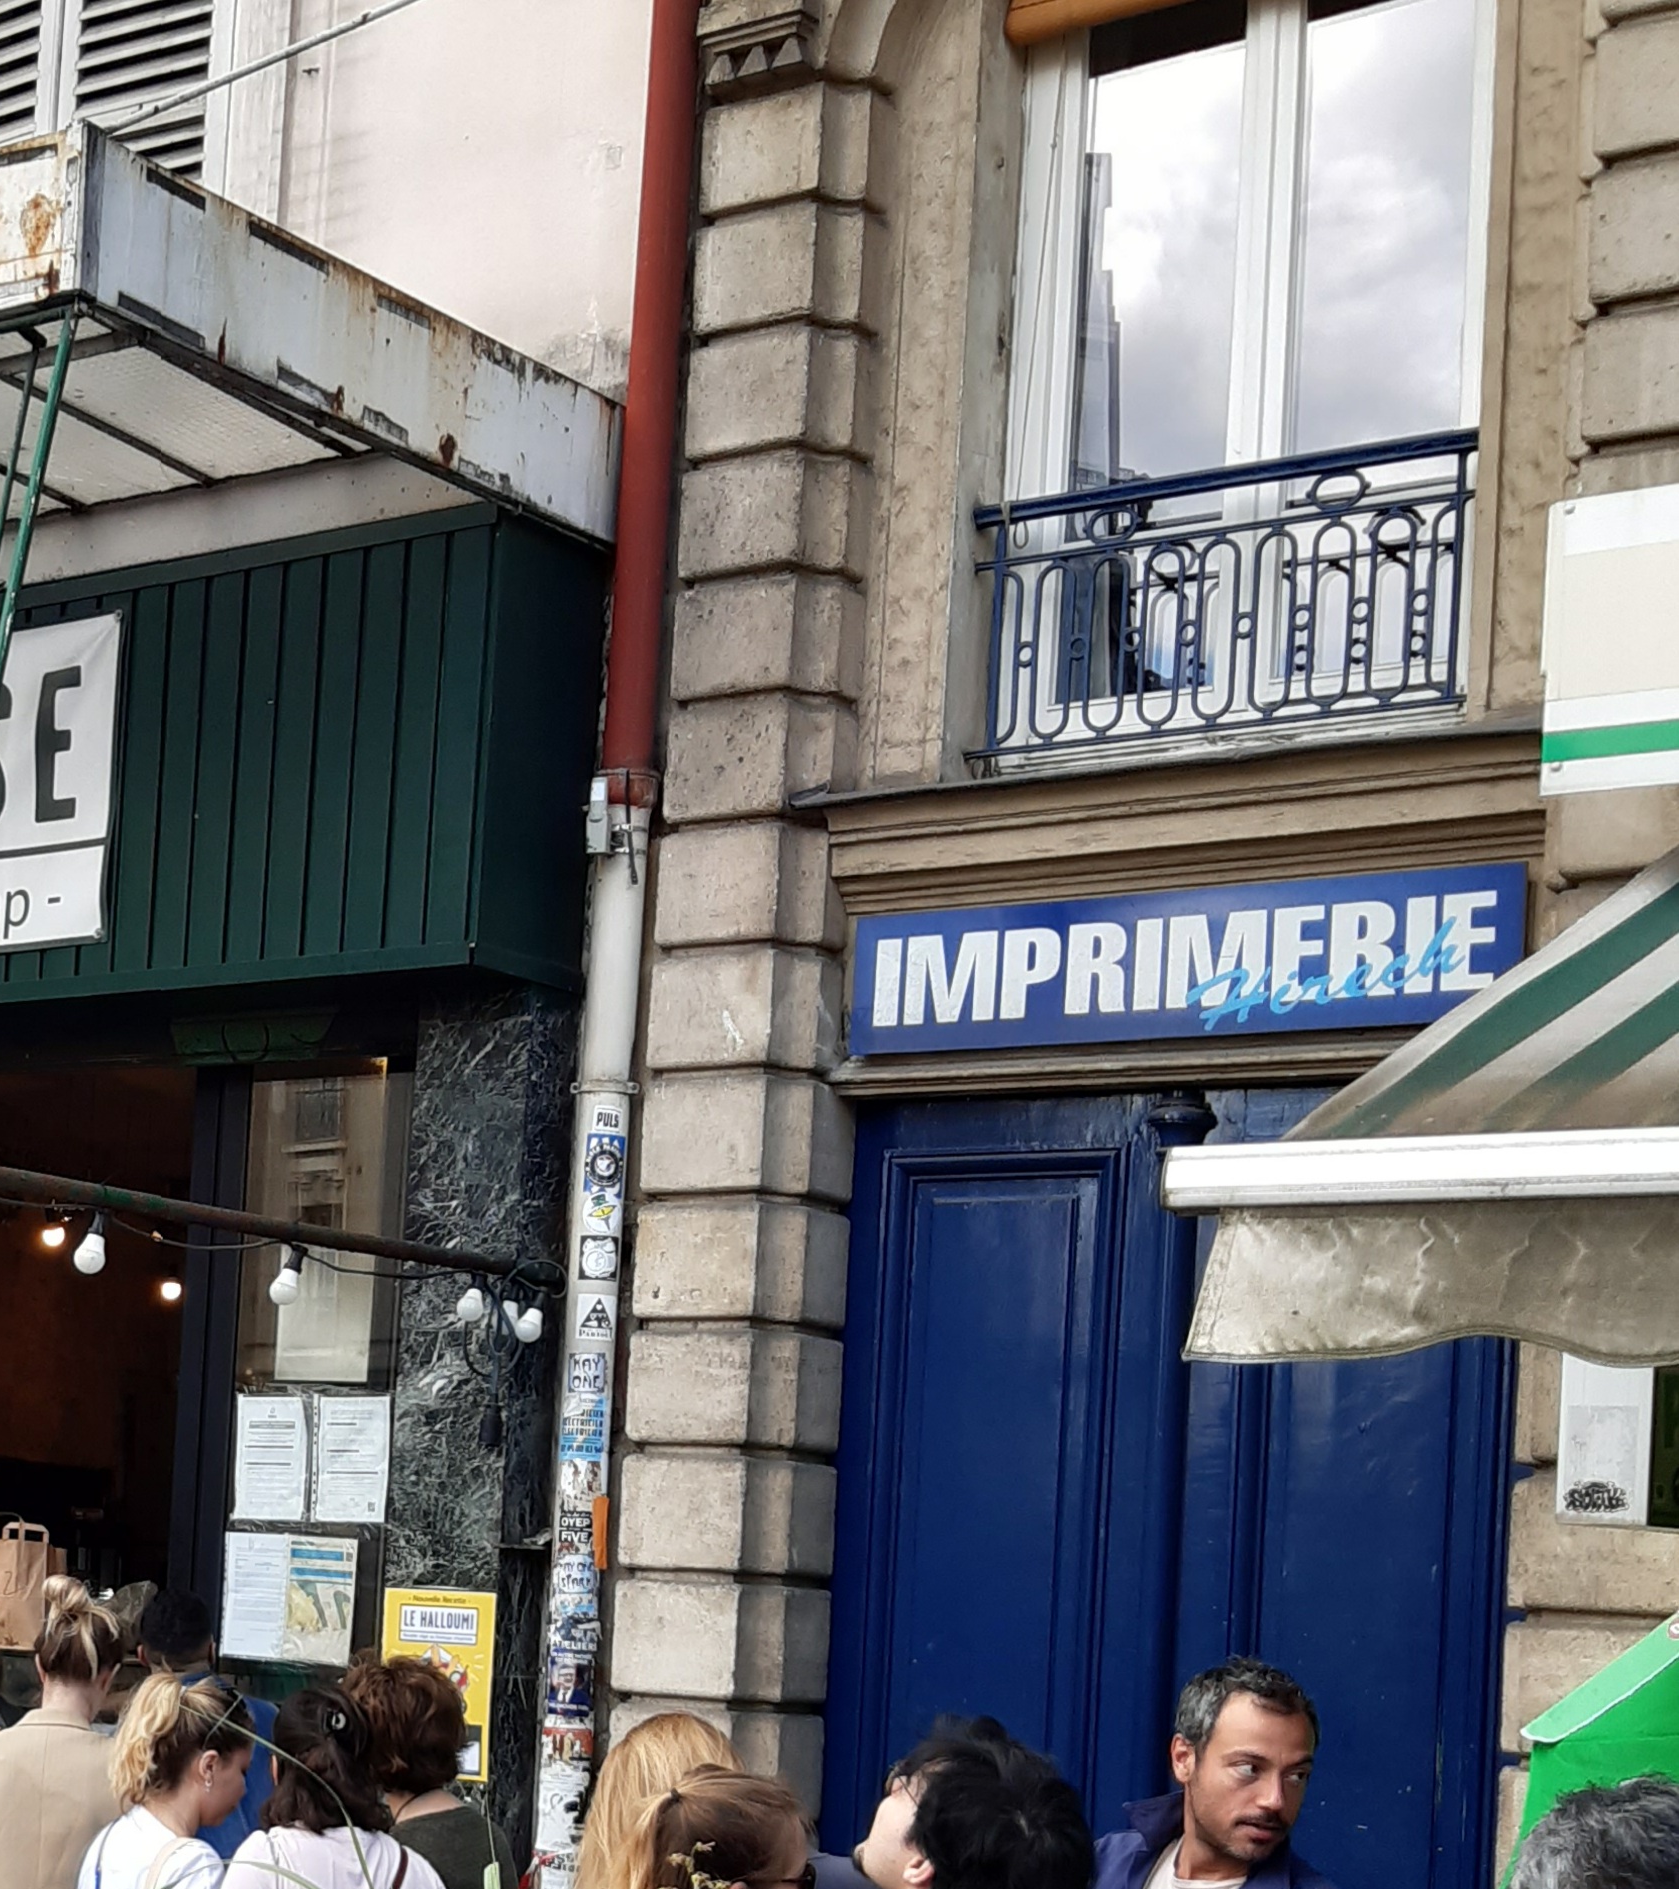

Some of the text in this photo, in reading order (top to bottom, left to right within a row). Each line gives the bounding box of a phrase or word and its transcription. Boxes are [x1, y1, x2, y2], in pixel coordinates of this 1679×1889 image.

[871, 889, 1498, 1028] IMPRIMERIE
[595, 1111, 620, 1129] PULS
[403, 1609, 474, 1631] LE HALLOUMI
